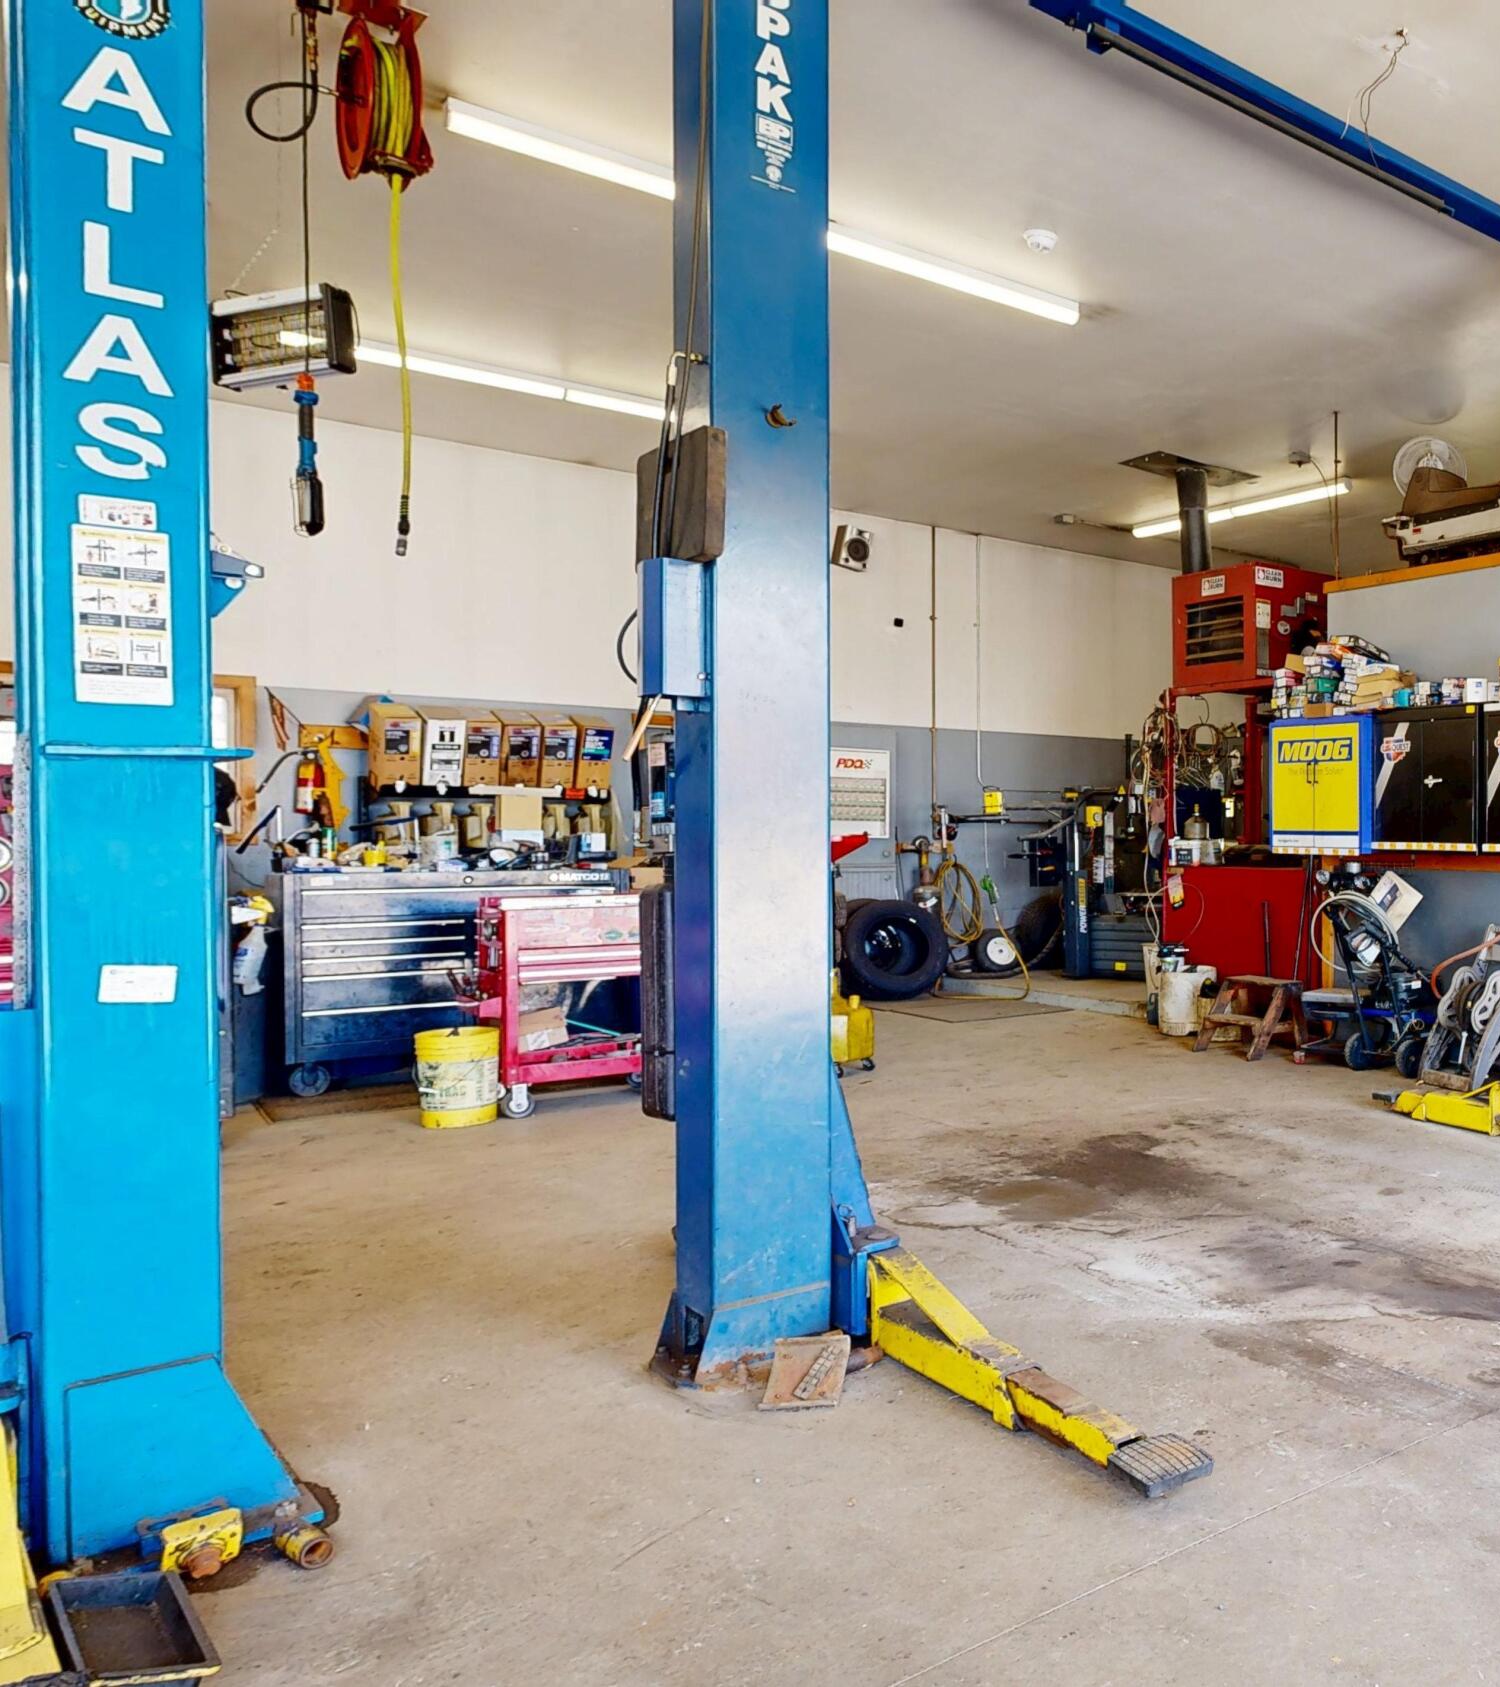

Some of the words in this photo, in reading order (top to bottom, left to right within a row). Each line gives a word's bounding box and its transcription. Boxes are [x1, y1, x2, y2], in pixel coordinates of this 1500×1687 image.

[61, 46, 174, 480] ATLAS
[1266, 575, 1282, 583] BURN
[1280, 739, 1350, 762] MOOG
[559, 872, 600, 881] MATCO
[1079, 906, 1088, 934] POWER
